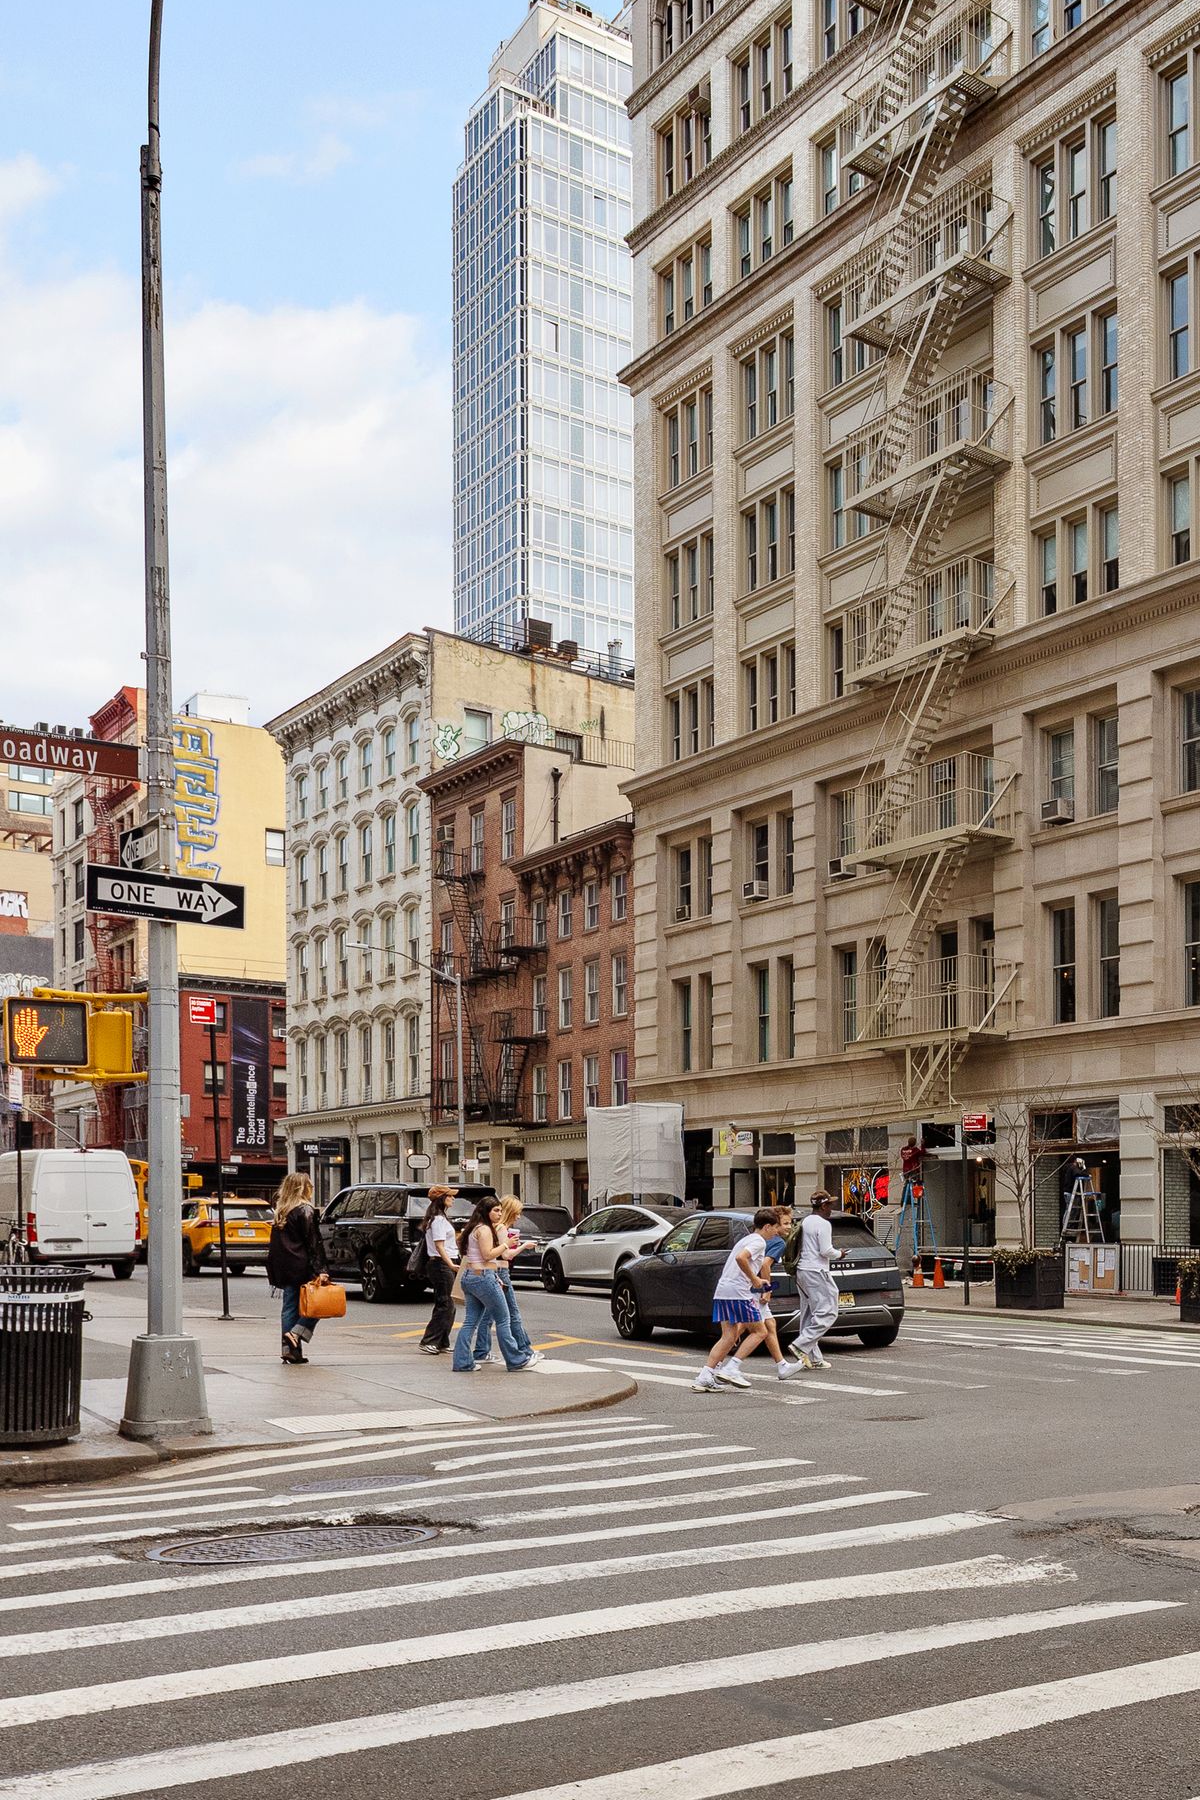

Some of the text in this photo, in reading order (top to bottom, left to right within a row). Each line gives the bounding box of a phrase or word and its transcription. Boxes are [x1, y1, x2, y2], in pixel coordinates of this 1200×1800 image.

[24, 730, 51, 739] HISTORIC
[51, 733, 77, 742] DISTRICT
[126, 831, 157, 862] ONE WAY
[111, 882, 222, 913] ONE WAY
[247, 1065, 258, 1144] Superintelligence
[237, 1127, 246, 1144] The
[257, 1118, 266, 1145] Cloud
